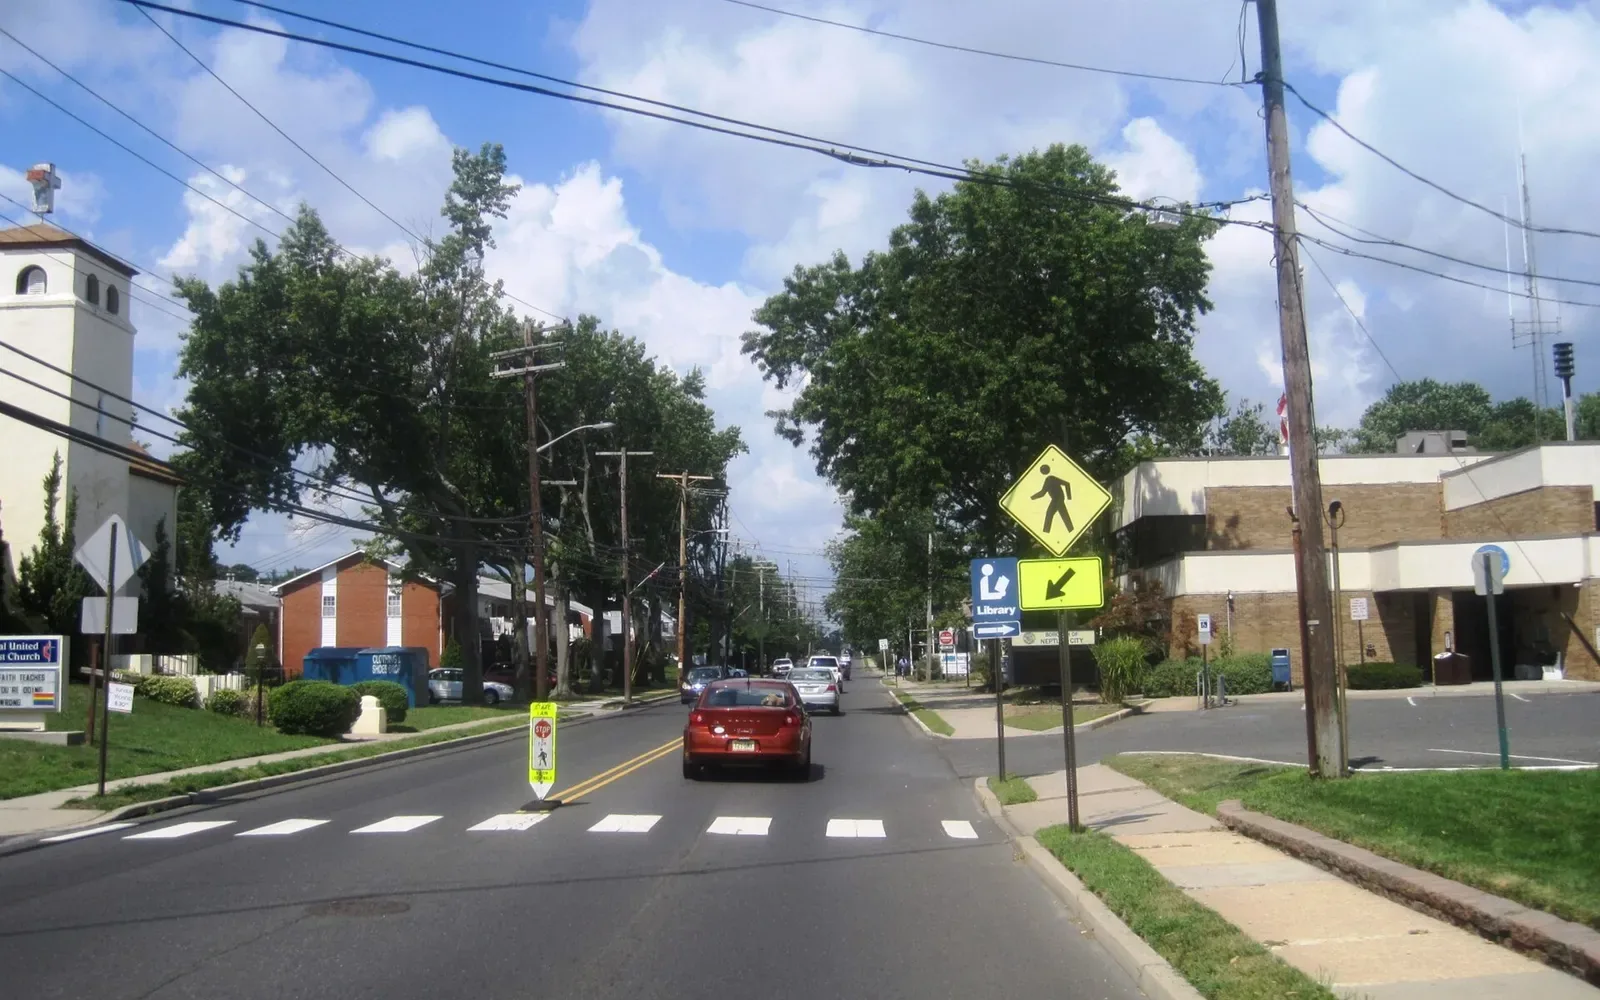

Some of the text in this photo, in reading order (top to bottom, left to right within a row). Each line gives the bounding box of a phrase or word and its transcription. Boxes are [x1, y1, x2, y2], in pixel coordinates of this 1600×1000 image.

[977, 605, 1016, 616] Library
[9, 642, 39, 650] United
[20, 673, 46, 682] TEACHES
[23, 686, 43, 694] DOING
